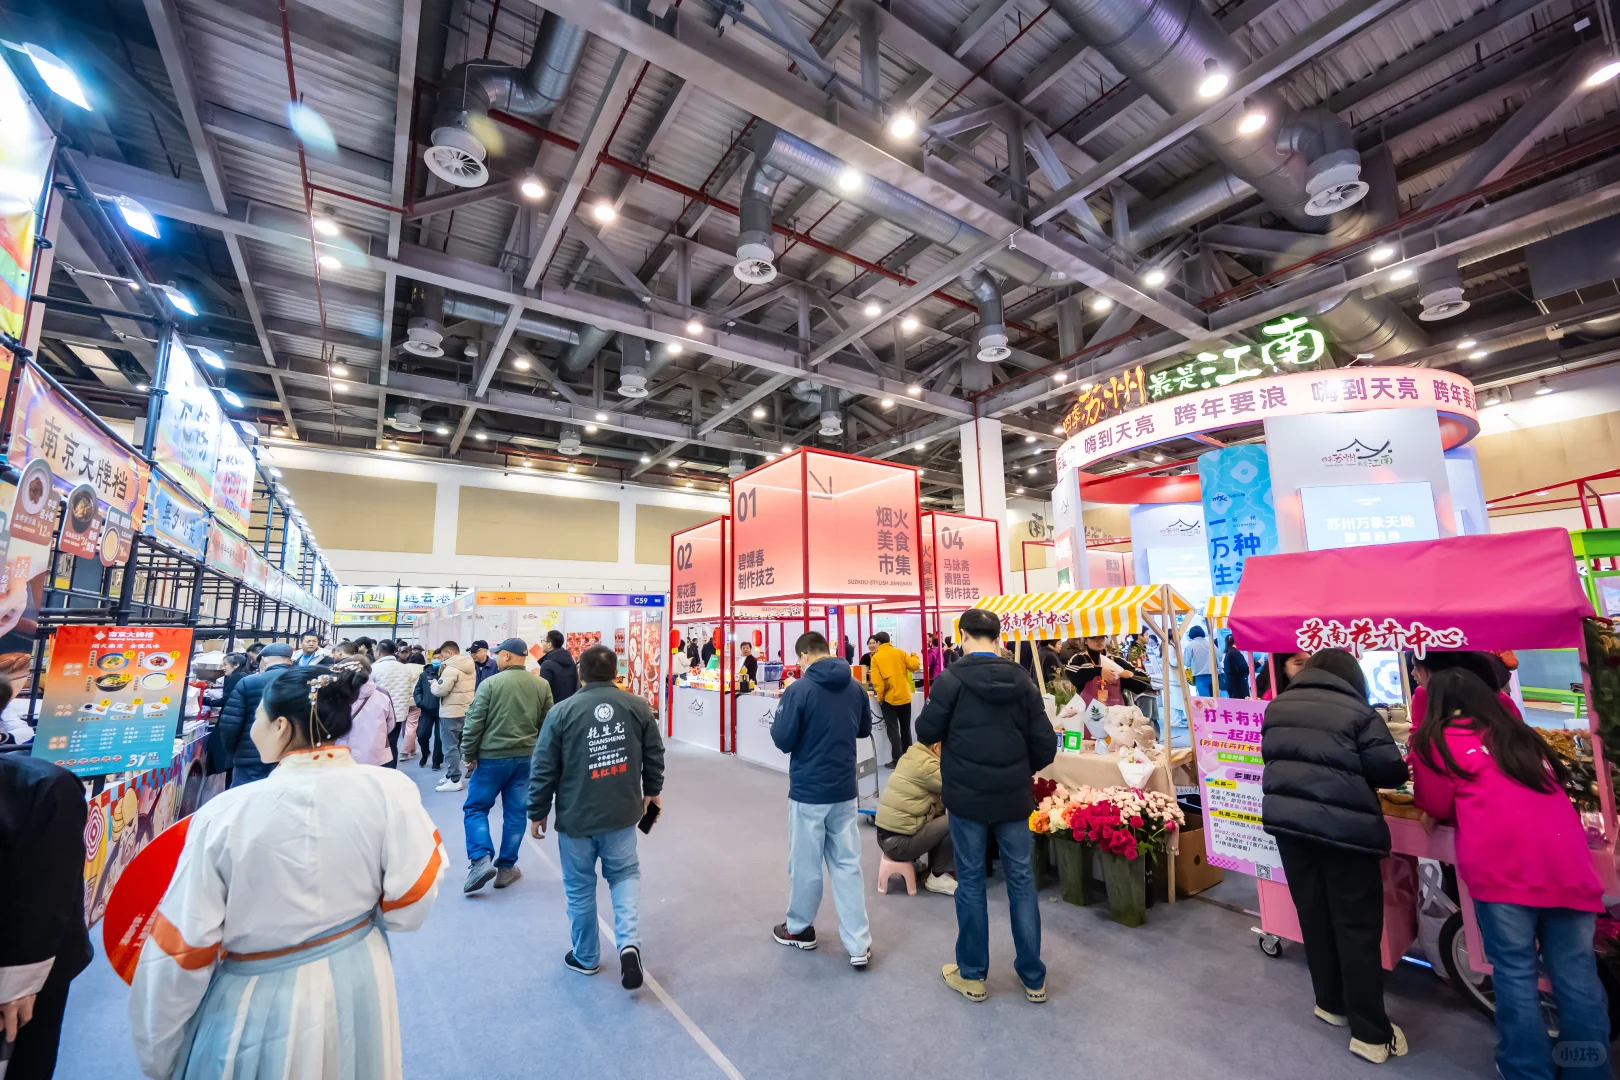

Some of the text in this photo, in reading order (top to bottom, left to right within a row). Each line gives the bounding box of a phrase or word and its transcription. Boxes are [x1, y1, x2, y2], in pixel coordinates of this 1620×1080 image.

[1084, 414, 1155, 454] 嗨到天亮
[1174, 386, 1288, 426] 跨年要浪
[1310, 376, 1419, 403] 嗨到天亮
[40, 416, 128, 501] 南京大牌档
[737, 488, 757, 523] 01
[876, 506, 909, 530] 烟火
[1326, 515, 1416, 531] 苏州万象天地
[877, 531, 911, 553] 美食
[941, 526, 964, 550] 04
[1210, 532, 1262, 560] 万种
[676, 543, 693, 572] 02
[738, 549, 765, 571] 碧螺春
[878, 554, 912, 576] 市集
[738, 566, 775, 591] 制作技艺
[633, 597, 648, 605] C59
[676, 582, 697, 600] 菊花酒
[944, 587, 980, 600] 制作技艺
[676, 599, 703, 616] 酿造技艺
[1000, 609, 1071, 635] 苏南花卉中心
[1298, 619, 1462, 659] 苏南花卉中心
[1204, 708, 1264, 727] 打卡有礼
[587, 722, 625, 739] 乾生元
[588, 734, 626, 747] QIANSHENG
[1212, 729, 1262, 743] 一起逛
[588, 744, 608, 753] YUAN
